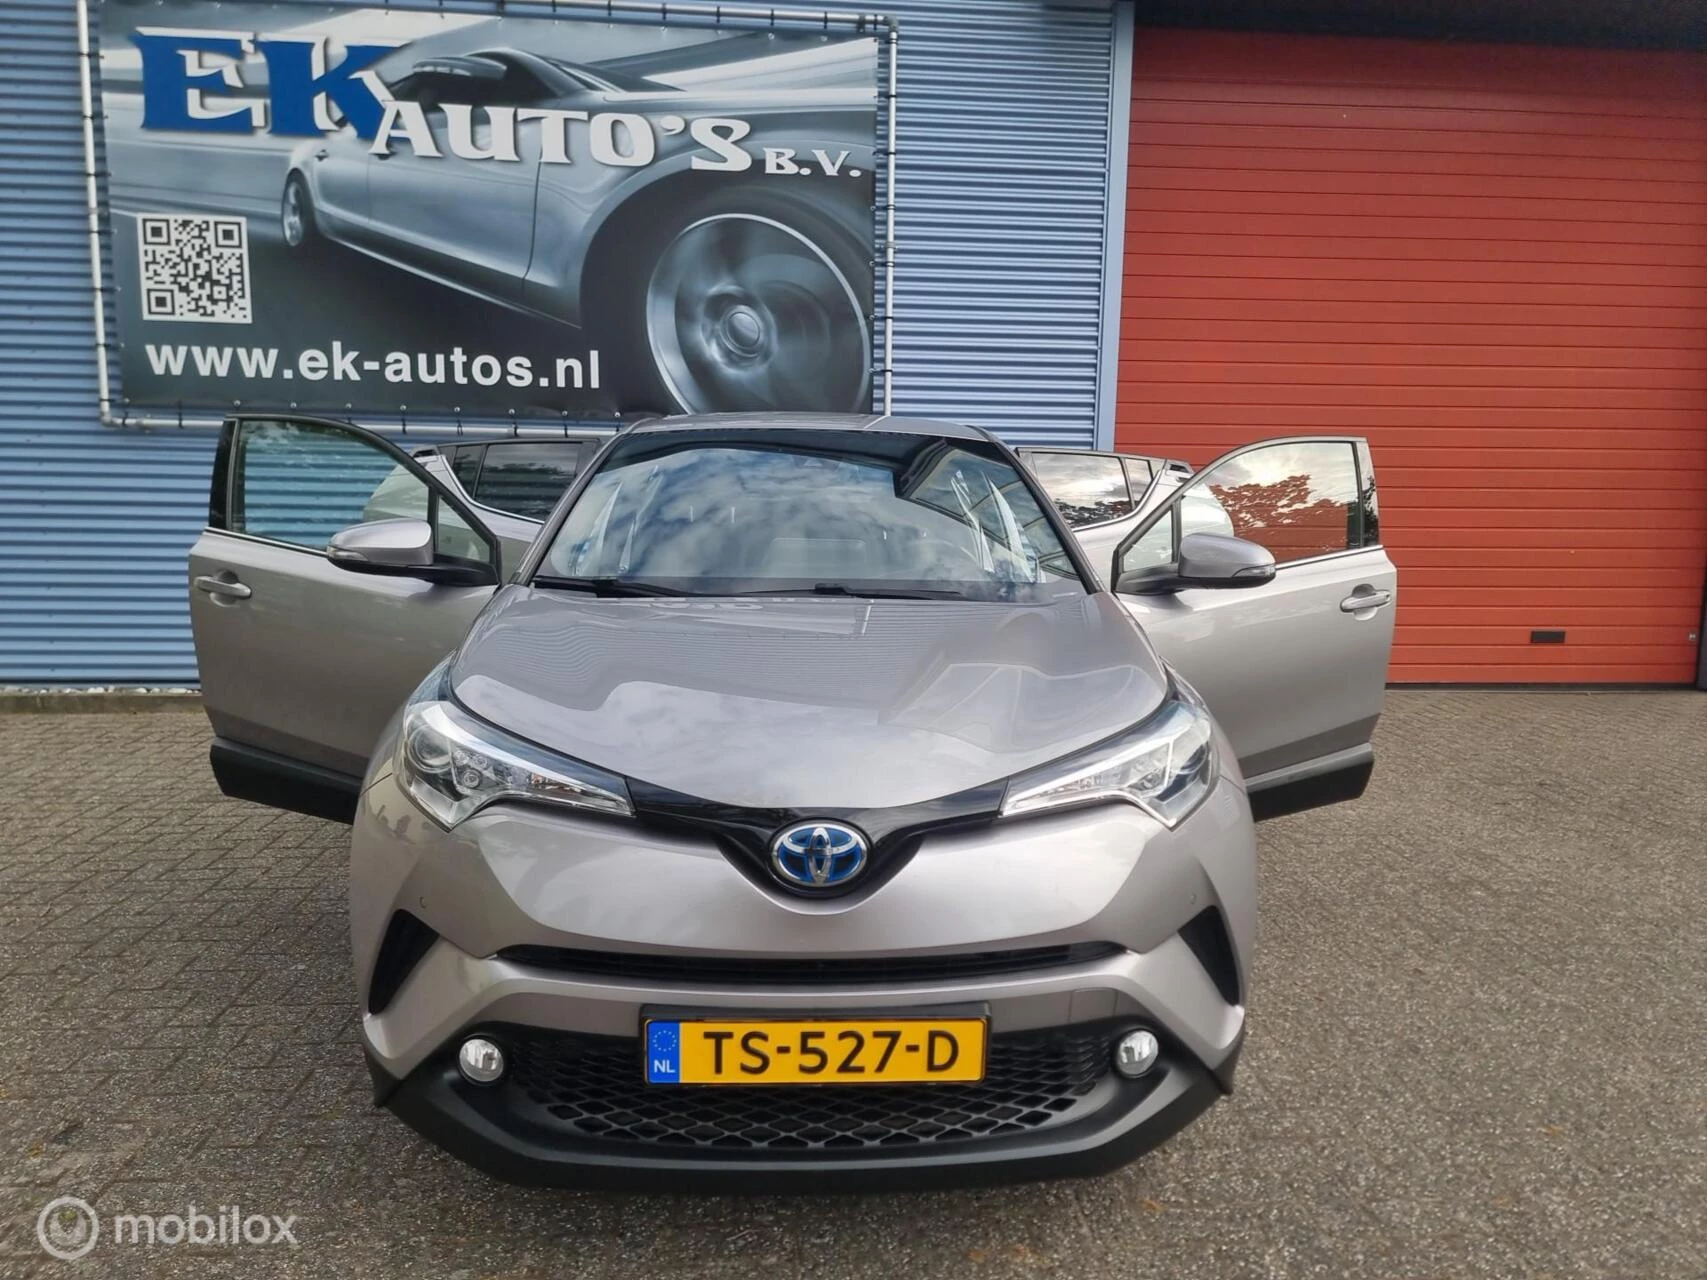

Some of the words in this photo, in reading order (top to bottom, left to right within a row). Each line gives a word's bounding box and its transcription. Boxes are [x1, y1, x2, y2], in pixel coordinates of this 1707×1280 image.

[131, 27, 408, 140] EK
[764, 147, 863, 178] B.V.
[145, 341, 600, 389] www.ek-autos.nl
[653, 1060, 676, 1073] NL
[704, 1031, 960, 1075] TS-527-D
